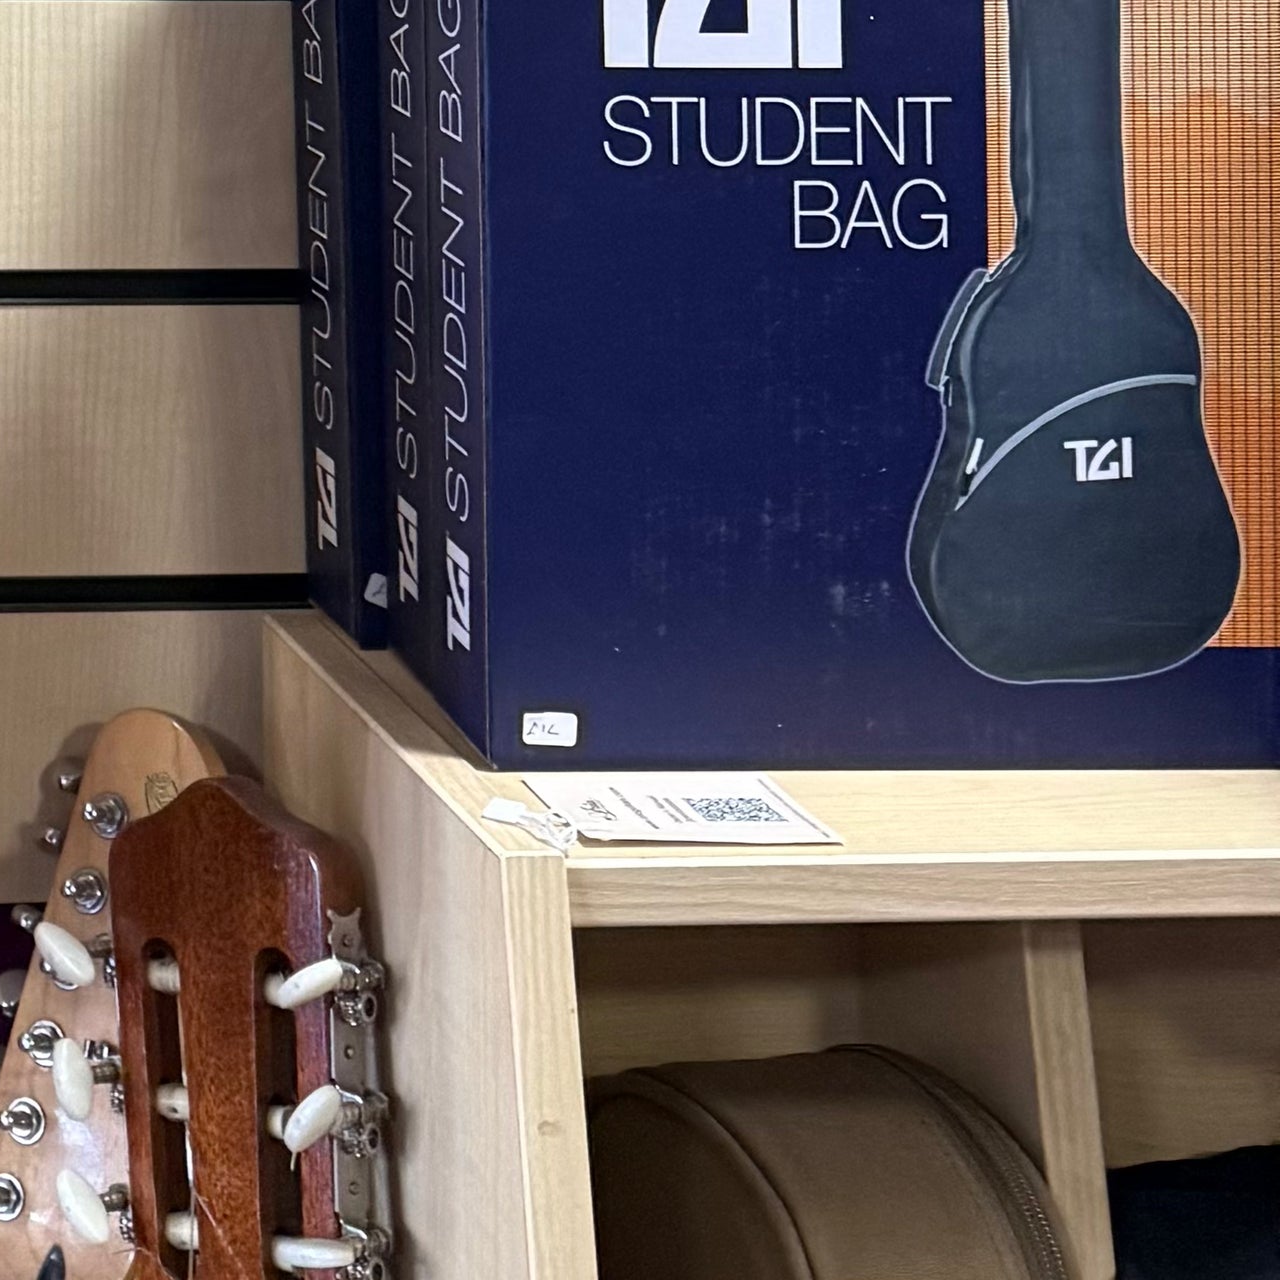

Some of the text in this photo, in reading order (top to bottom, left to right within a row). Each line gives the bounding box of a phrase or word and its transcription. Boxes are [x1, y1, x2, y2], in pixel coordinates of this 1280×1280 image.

[603, 94, 953, 167] STUDENT
[793, 178, 949, 250] BAG
[304, 99, 334, 430] STUDENT
[391, 132, 418, 479] STUDENT
[440, 156, 470, 523] STUDENT
[1063, 436, 1134, 482] TGI
